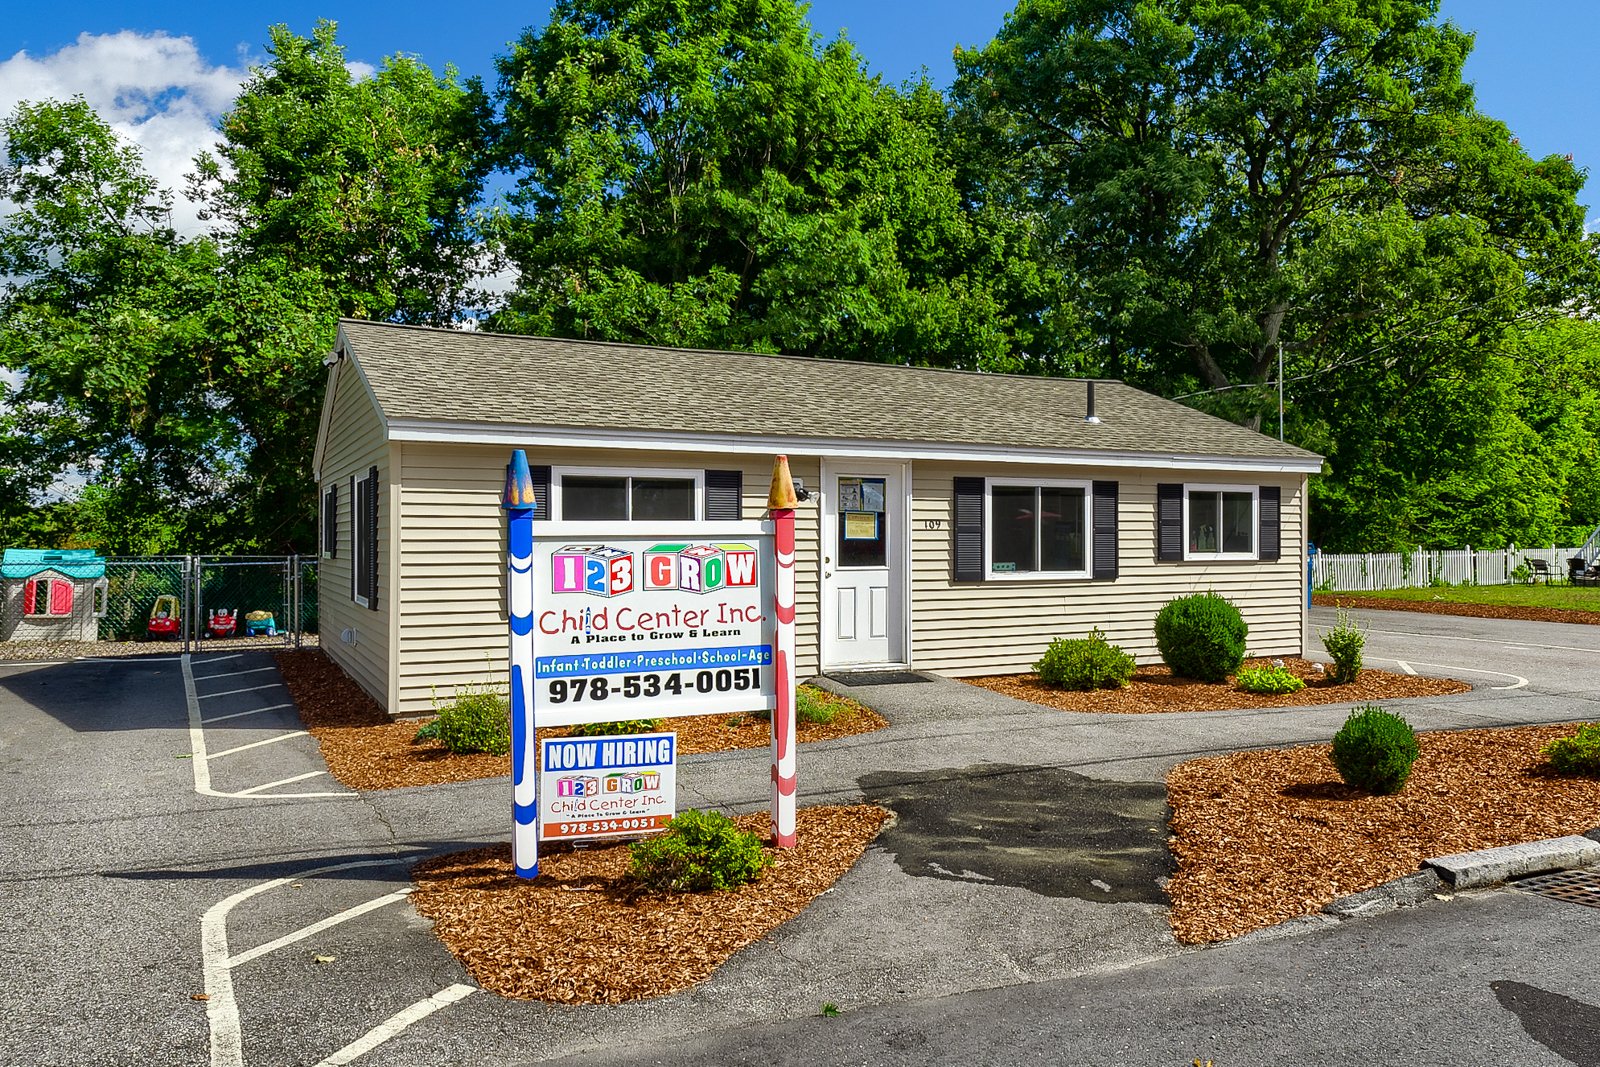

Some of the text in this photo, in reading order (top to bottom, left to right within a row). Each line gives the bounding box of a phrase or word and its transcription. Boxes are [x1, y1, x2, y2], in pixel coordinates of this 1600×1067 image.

[924, 520, 941, 530] 109
[563, 553, 755, 593] 123 GROW
[539, 602, 767, 635] Child Center Inc.
[571, 628, 742, 645] A Place to Grow & Learn
[537, 649, 770, 674] Infant Toddler Preschool School-Age
[548, 667, 761, 704] 978-534-0051
[548, 739, 670, 770] NOW HIRING
[561, 775, 660, 796] 123 GROW
[551, 795, 667, 814] Child Center Inc.
[560, 818, 656, 835] 978-534-0051
